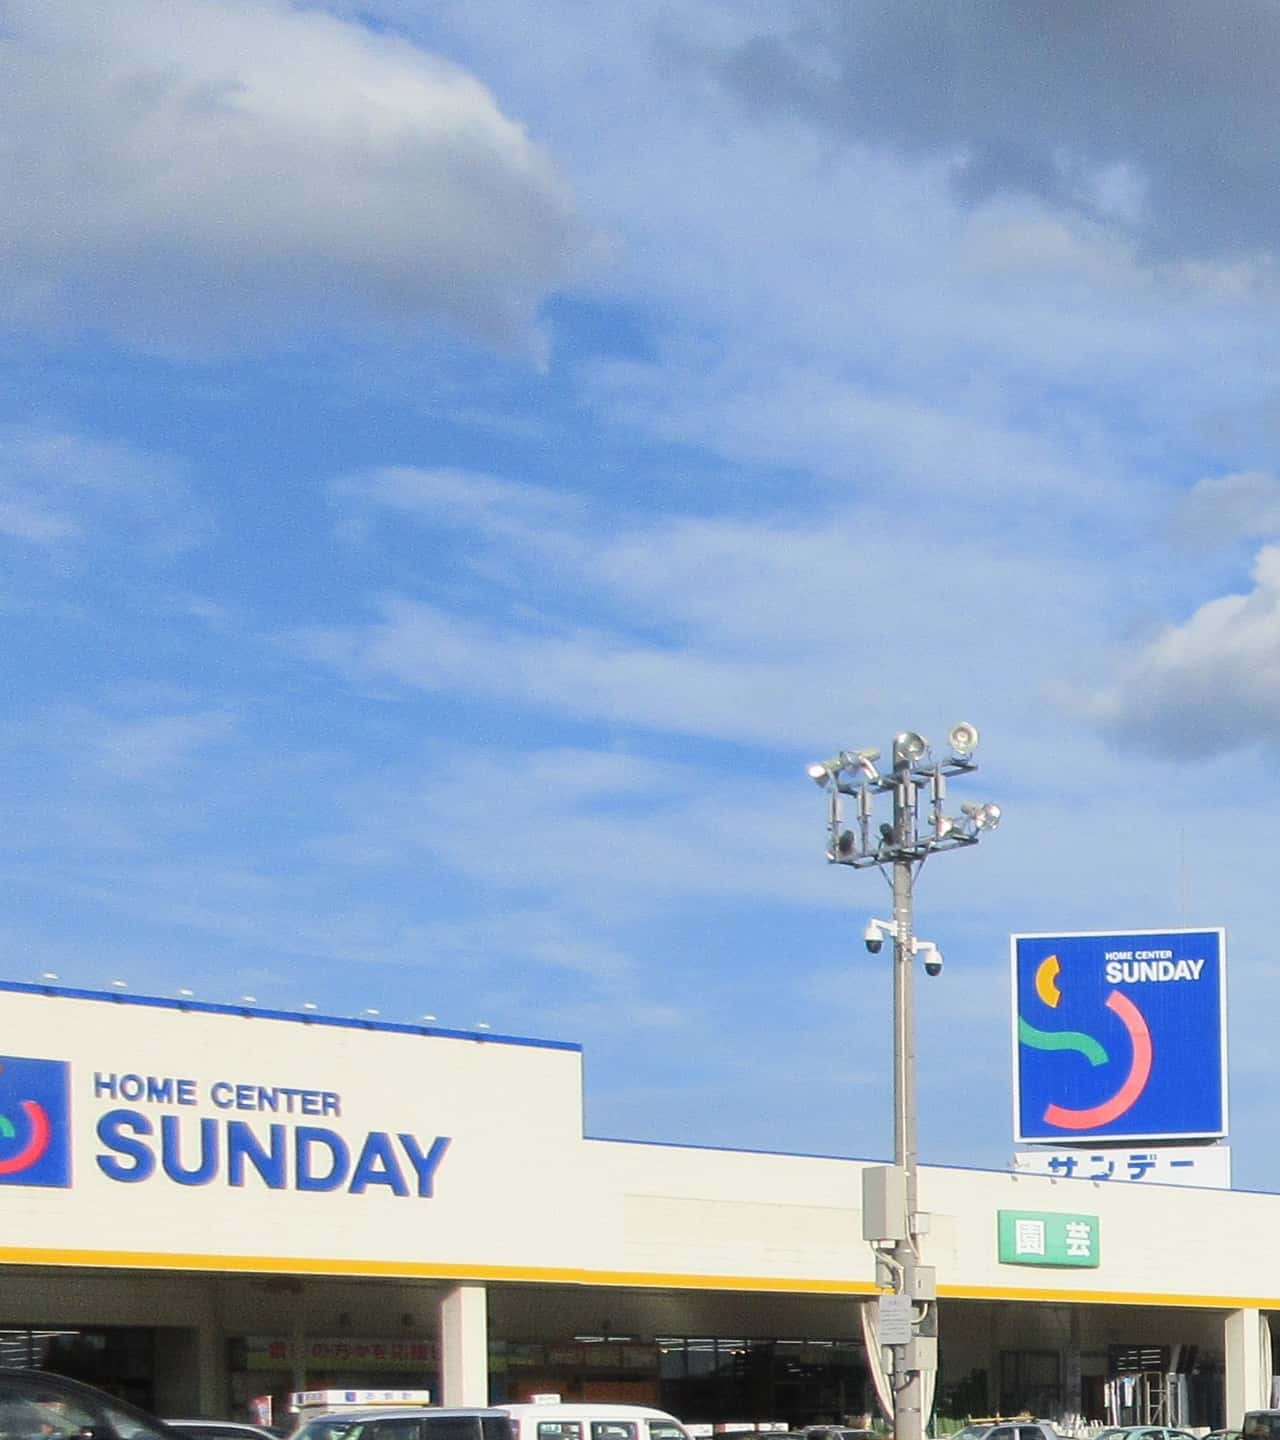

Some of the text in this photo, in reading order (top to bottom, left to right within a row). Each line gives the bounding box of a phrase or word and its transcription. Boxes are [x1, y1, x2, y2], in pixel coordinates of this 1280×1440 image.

[1105, 950, 1173, 961] HOME CENTER
[1105, 959, 1205, 984] SUNDAY
[94, 1071, 342, 1117] HOME CENTER
[95, 1108, 453, 1199] SUNDAY
[1048, 1154, 1195, 1181] サンデー
[1015, 1218, 1092, 1258] 園芸
